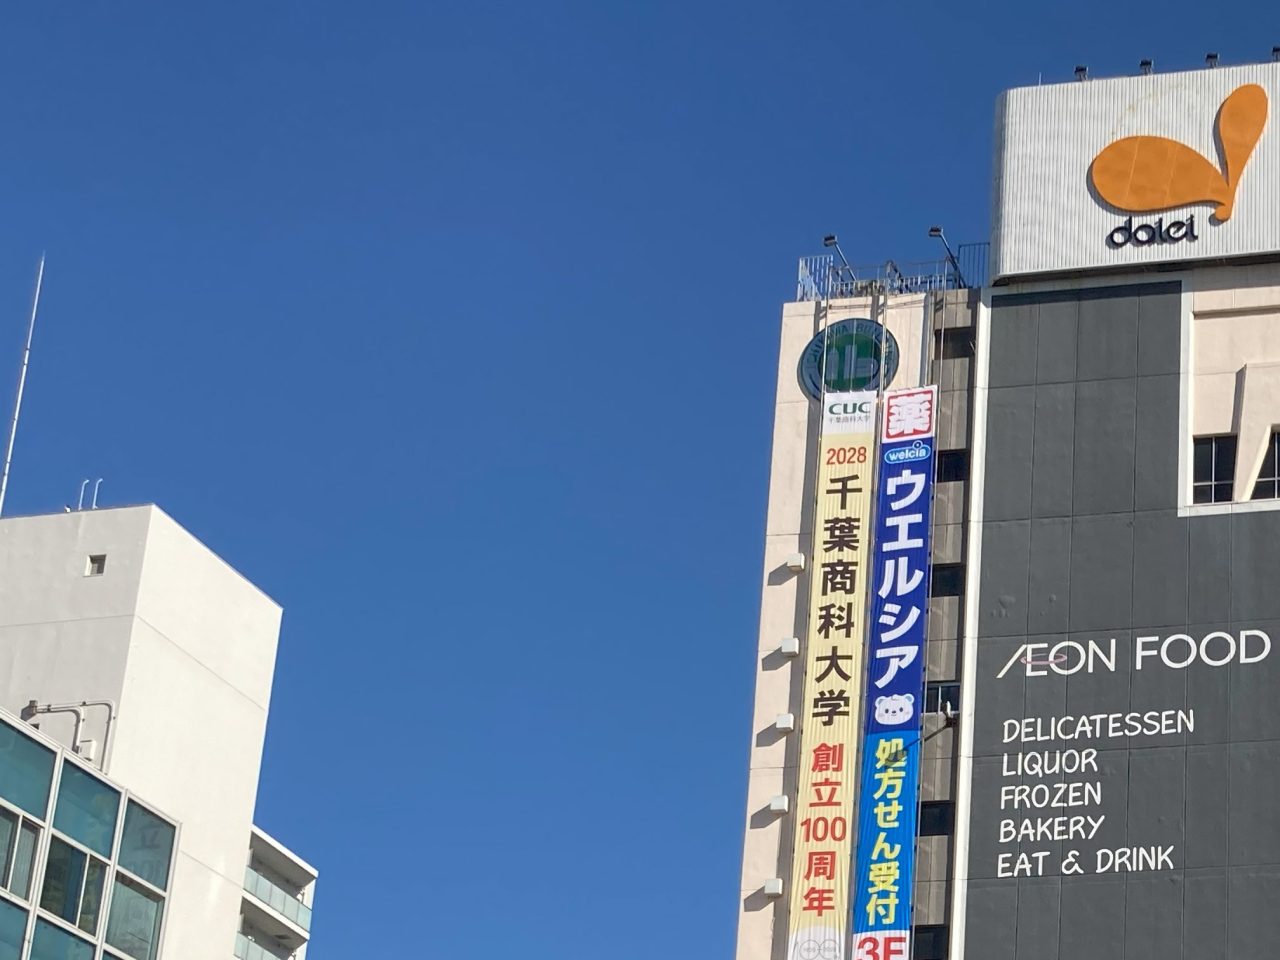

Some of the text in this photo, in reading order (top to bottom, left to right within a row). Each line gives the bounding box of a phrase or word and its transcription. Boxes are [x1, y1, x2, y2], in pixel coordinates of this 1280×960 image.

[1109, 215, 1198, 247] daiei
[828, 401, 871, 415] CUC
[887, 393, 931, 436] 薬
[826, 447, 867, 465] 2028
[888, 441, 927, 461] welcia
[875, 469, 925, 689] ウエルシア
[1135, 629, 1271, 670] FOOD
[1002, 709, 1195, 743] DELICATESSEN
[1002, 748, 1098, 778] LIQUOR
[1000, 782, 1101, 810] FROZEN
[866, 738, 906, 926] 処方せん受付
[998, 815, 1105, 843] BAKERY
[997, 845, 1175, 878] EAT & DRINK
